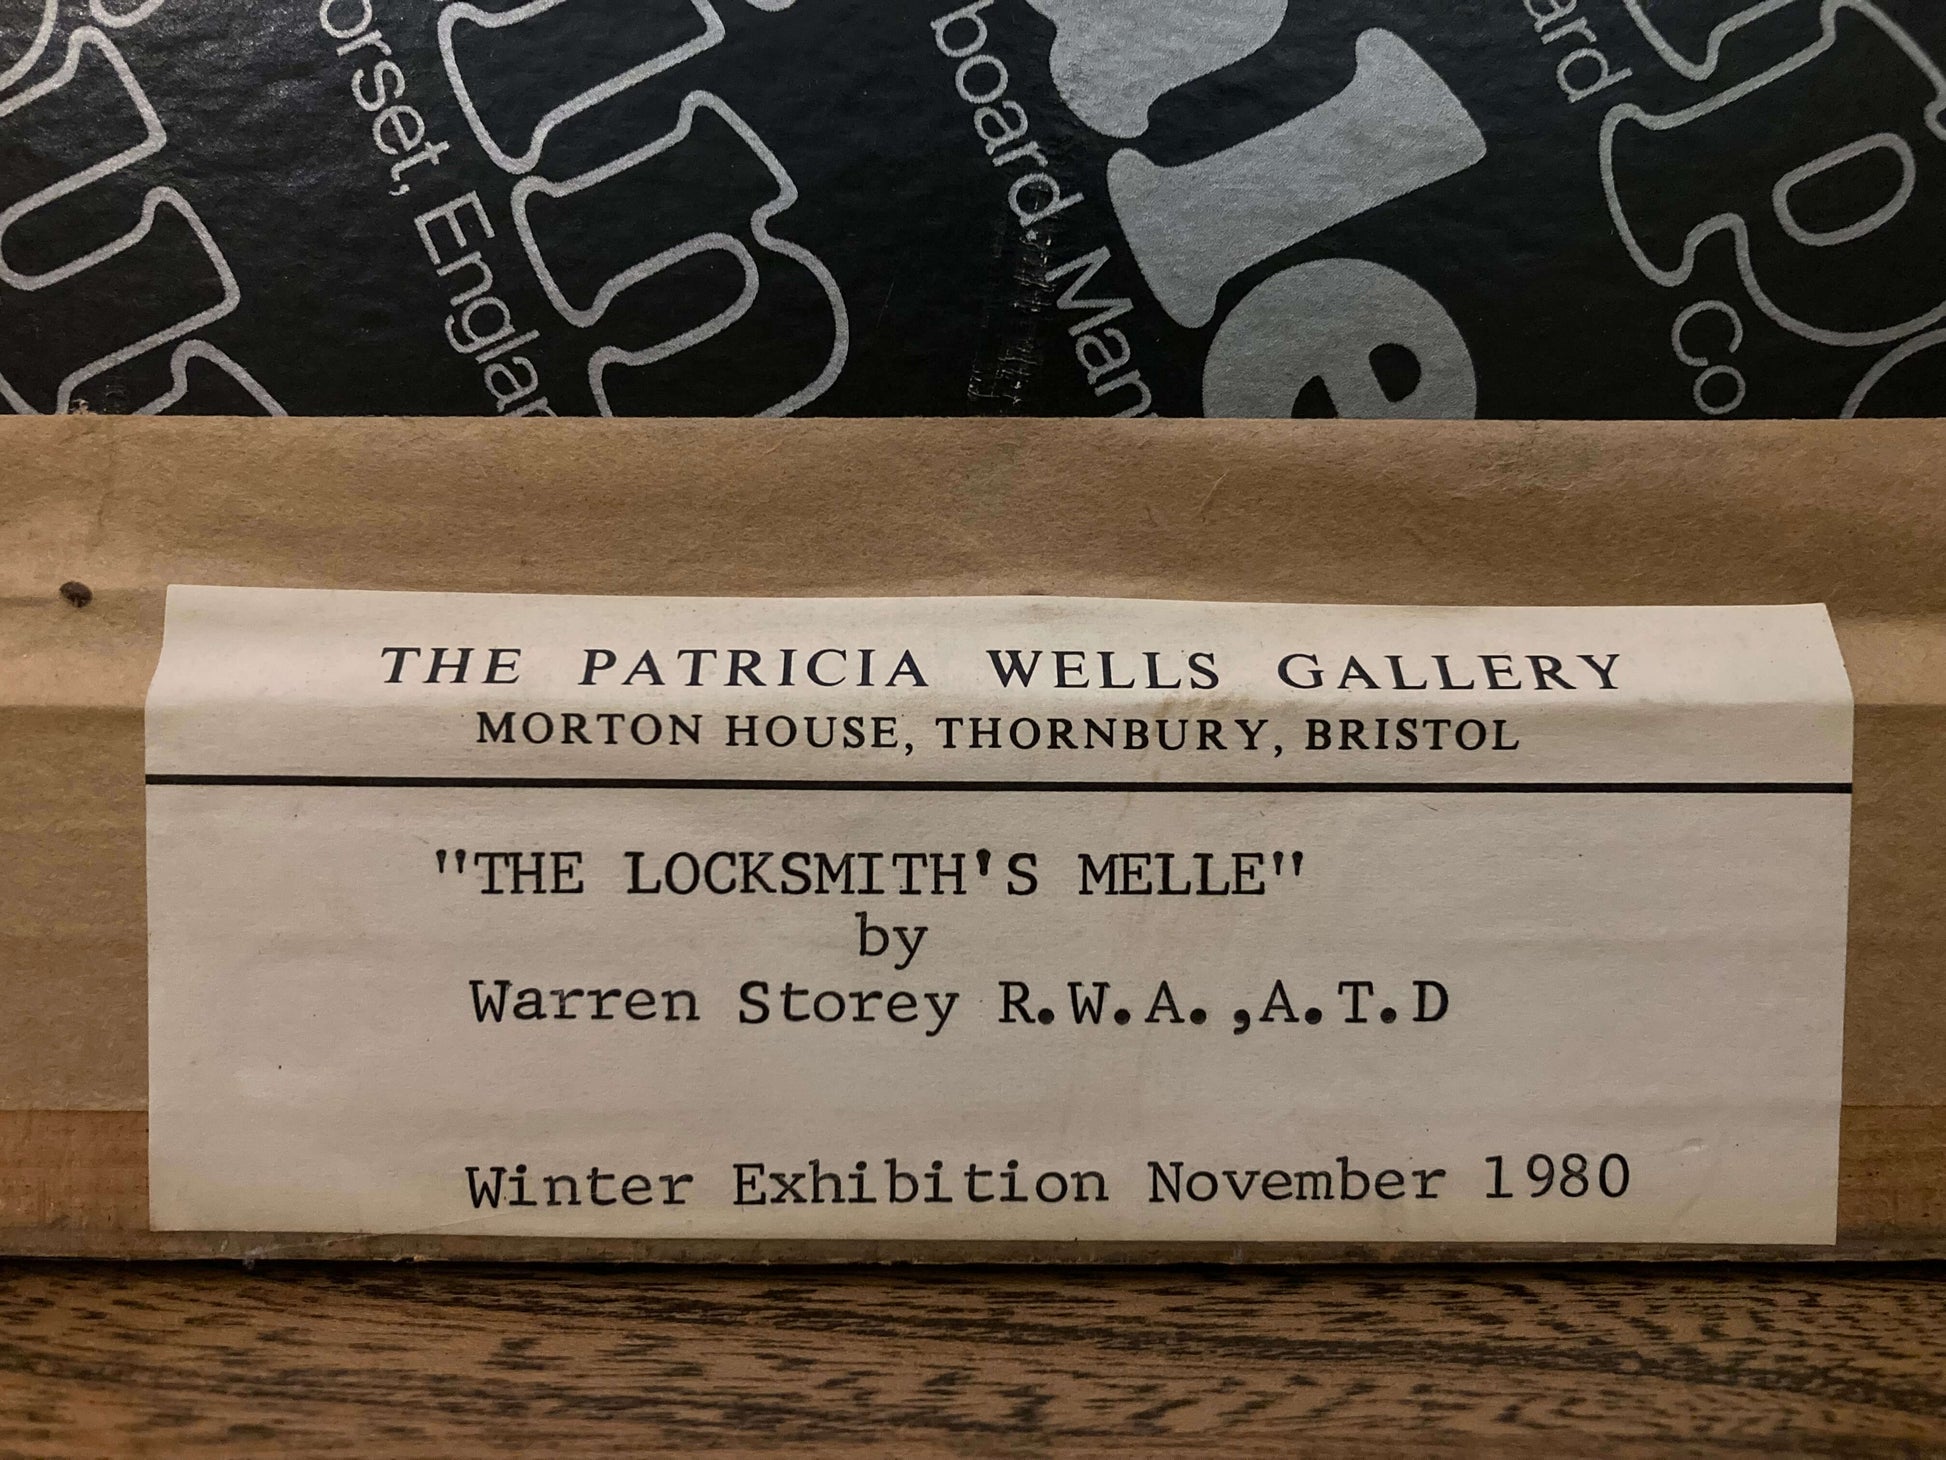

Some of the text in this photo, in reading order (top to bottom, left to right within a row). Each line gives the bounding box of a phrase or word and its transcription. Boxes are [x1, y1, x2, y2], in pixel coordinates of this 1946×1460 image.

[930, 0, 1159, 418] board. Man
[1671, 299, 1747, 416] Co
[380, 646, 1624, 692] THE PATRICIA WELLS GALLERY
[475, 711, 1520, 759] MORTON HOUSE, THORNBURY, BRISTOL
[435, 847, 1305, 897] "THE LOCKSMITH'S MELLE"
[854, 910, 929, 971] by
[468, 979, 701, 1025] Warren
[738, 979, 961, 1038] Storey
[464, 1152, 1631, 1211] Winter Exhibition November 1980
